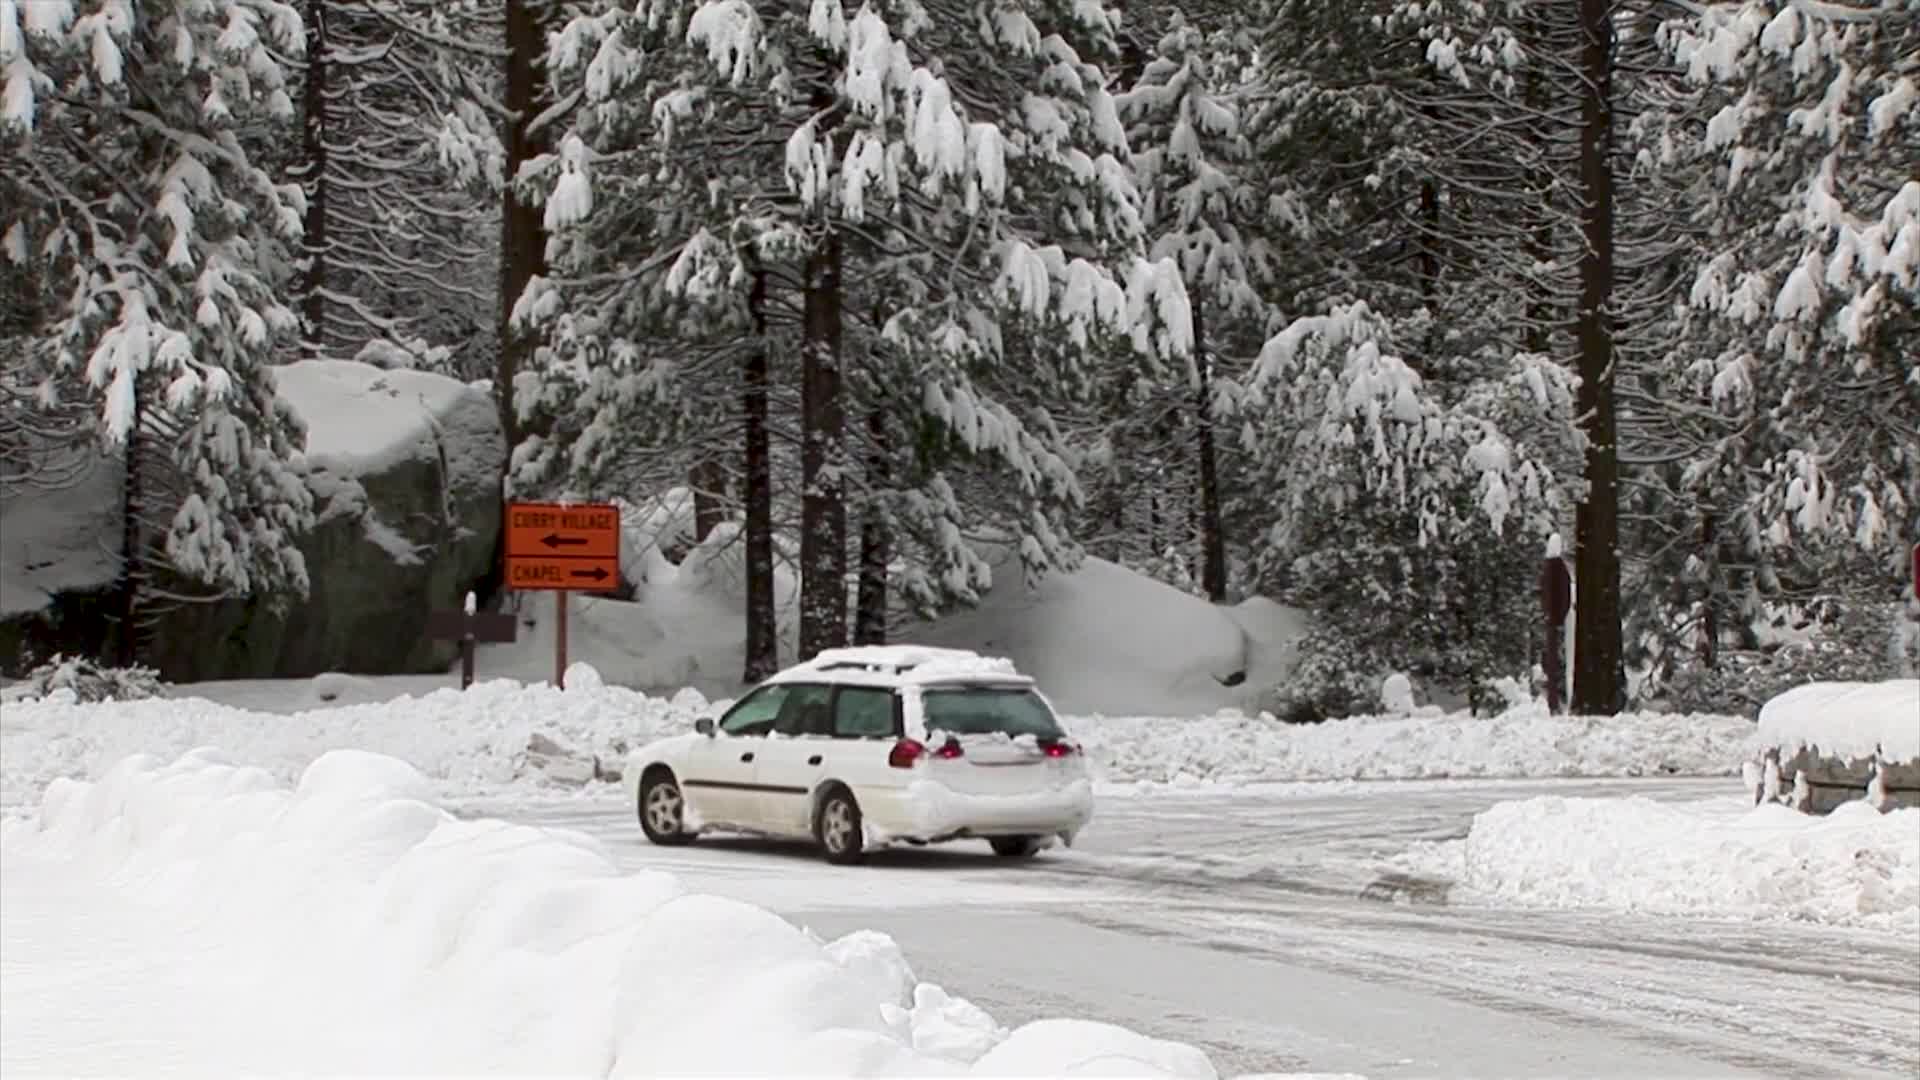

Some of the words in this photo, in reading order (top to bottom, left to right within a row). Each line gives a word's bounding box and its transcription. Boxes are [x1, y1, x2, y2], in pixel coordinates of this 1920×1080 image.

[513, 512, 555, 529] CURRY
[561, 513, 613, 530] VILLAGE
[513, 565, 564, 582] CHAPEL
